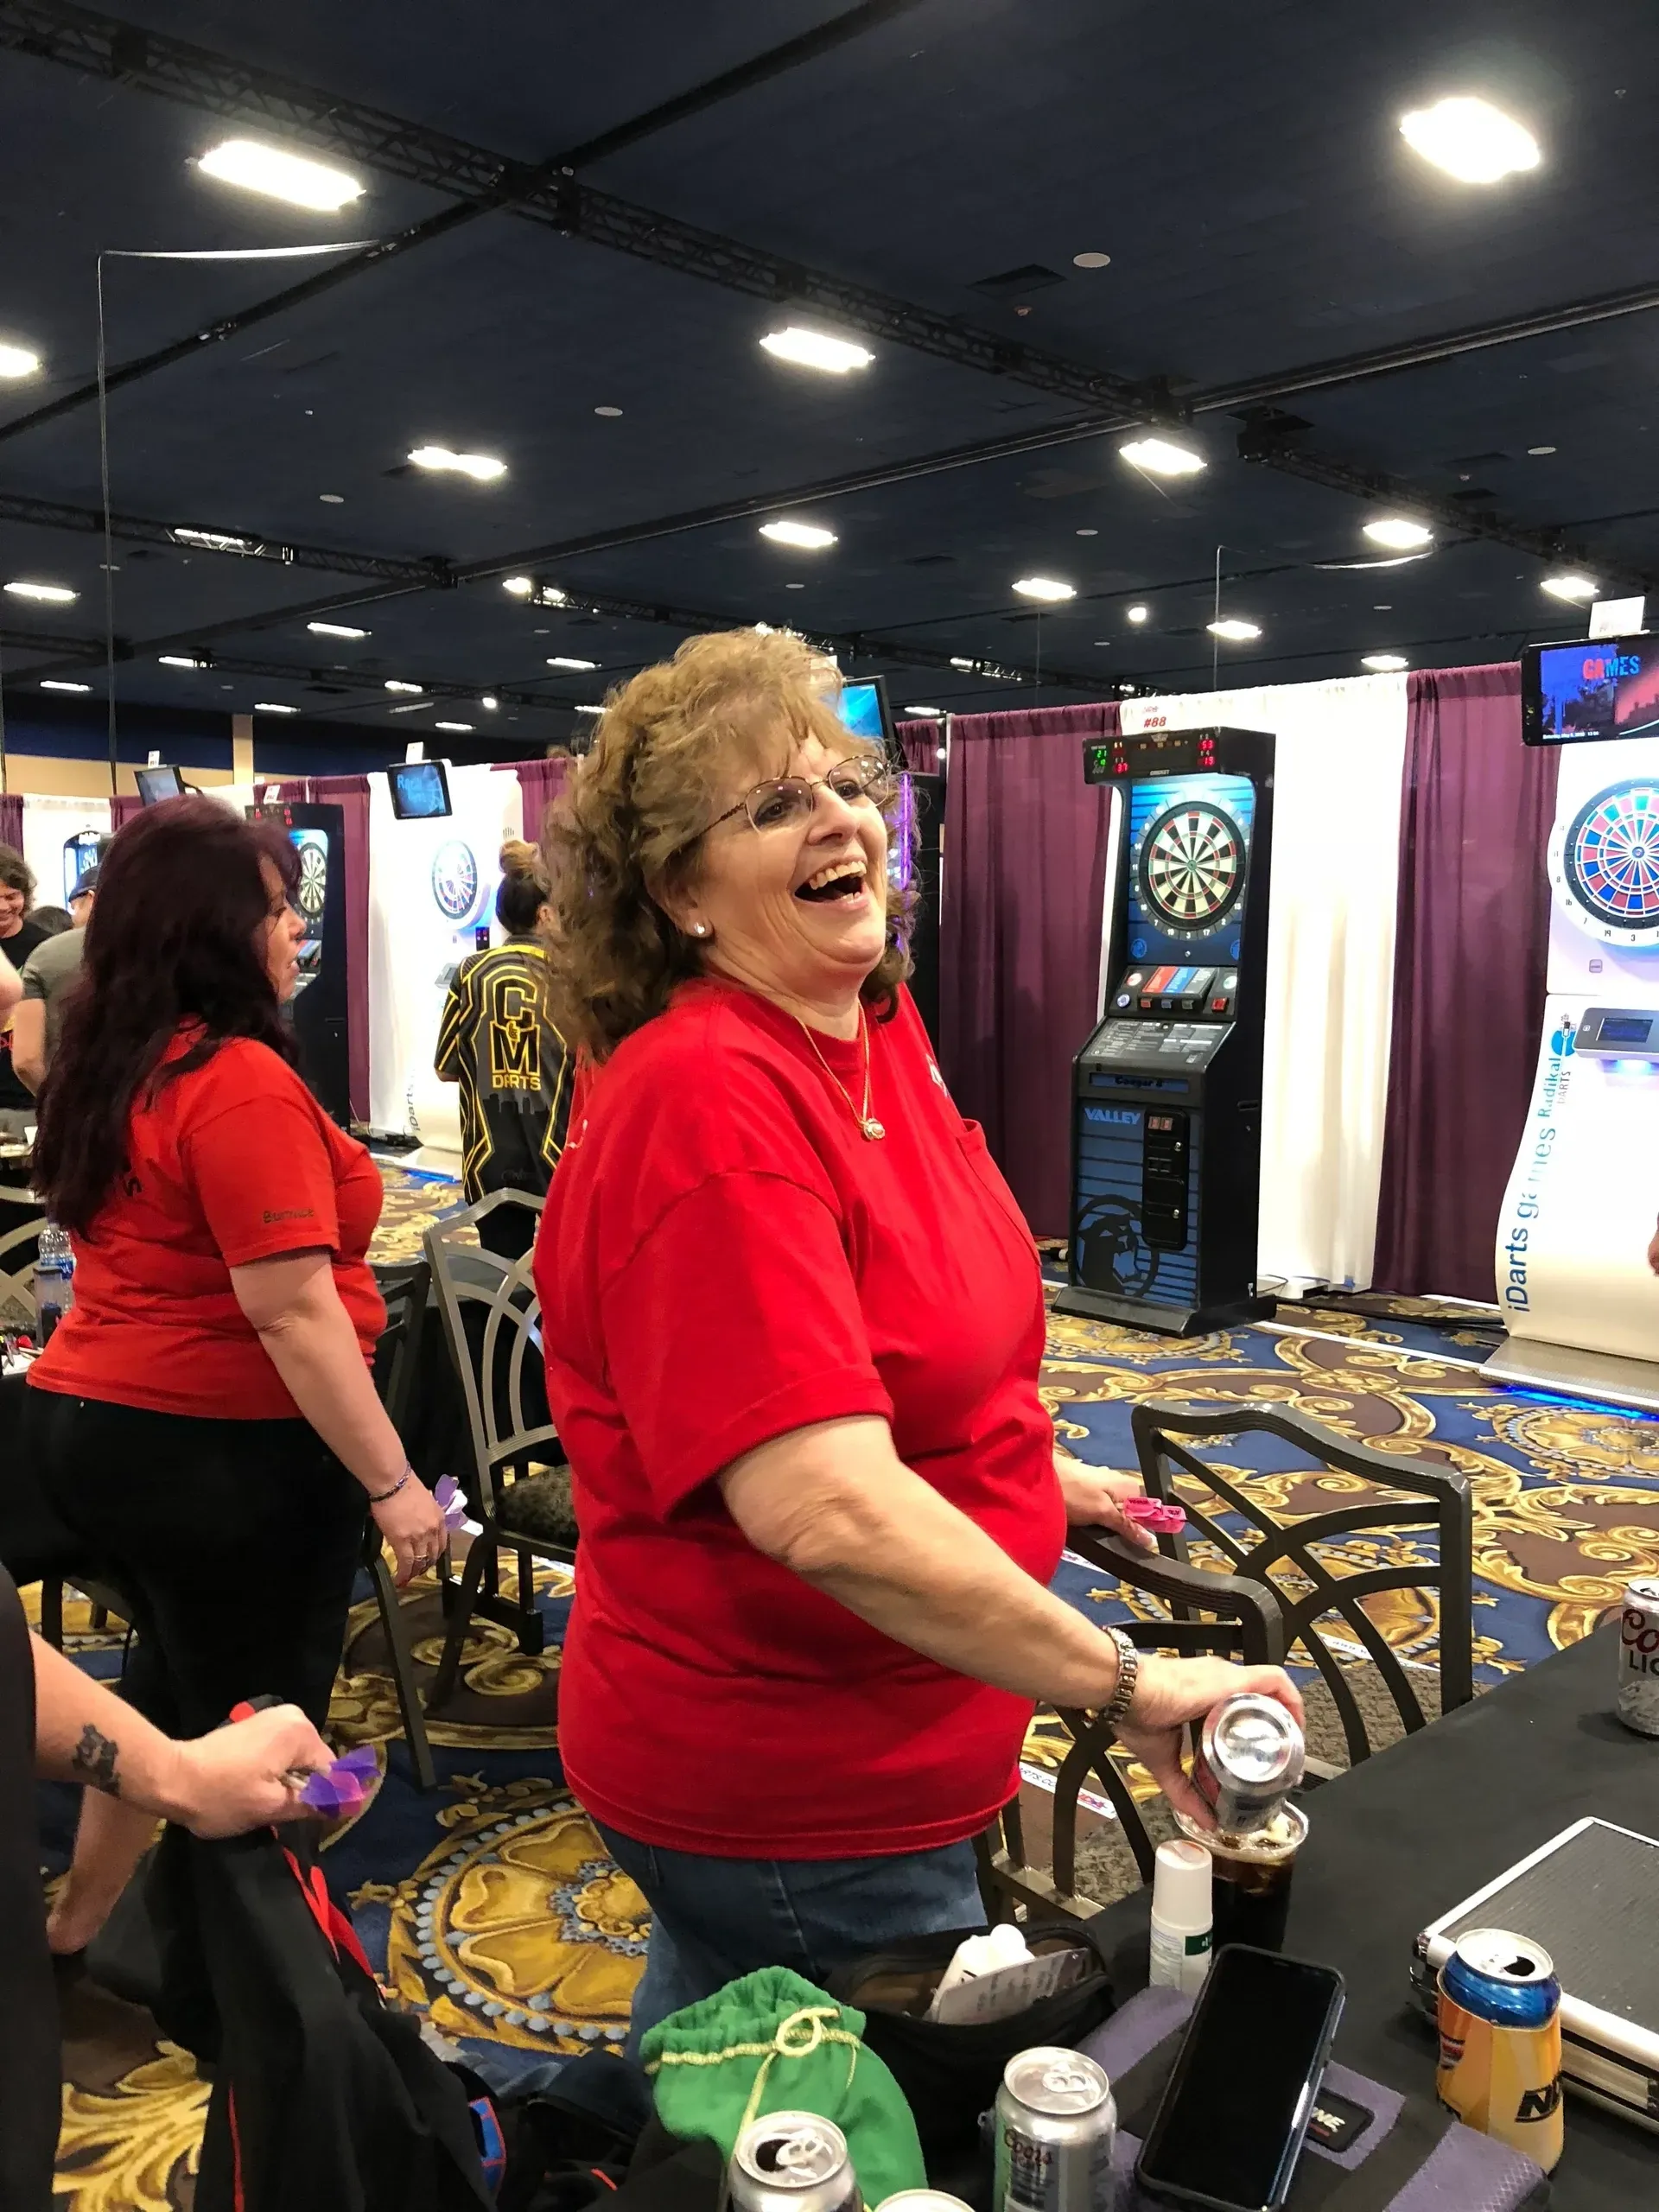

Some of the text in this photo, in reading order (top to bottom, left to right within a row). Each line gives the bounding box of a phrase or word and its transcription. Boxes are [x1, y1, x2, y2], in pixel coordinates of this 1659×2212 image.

[1143, 716, 1166, 728] #88
[493, 975, 537, 1032] C
[489, 1020, 540, 1077] M
[492, 1074, 542, 1091] DARTS
[1537, 1057, 1561, 1118] Radikal
[1556, 1071, 1571, 1104] DARTS
[1084, 1108, 1141, 1124] VALLEY
[1504, 1226, 1530, 1313] iDarts
